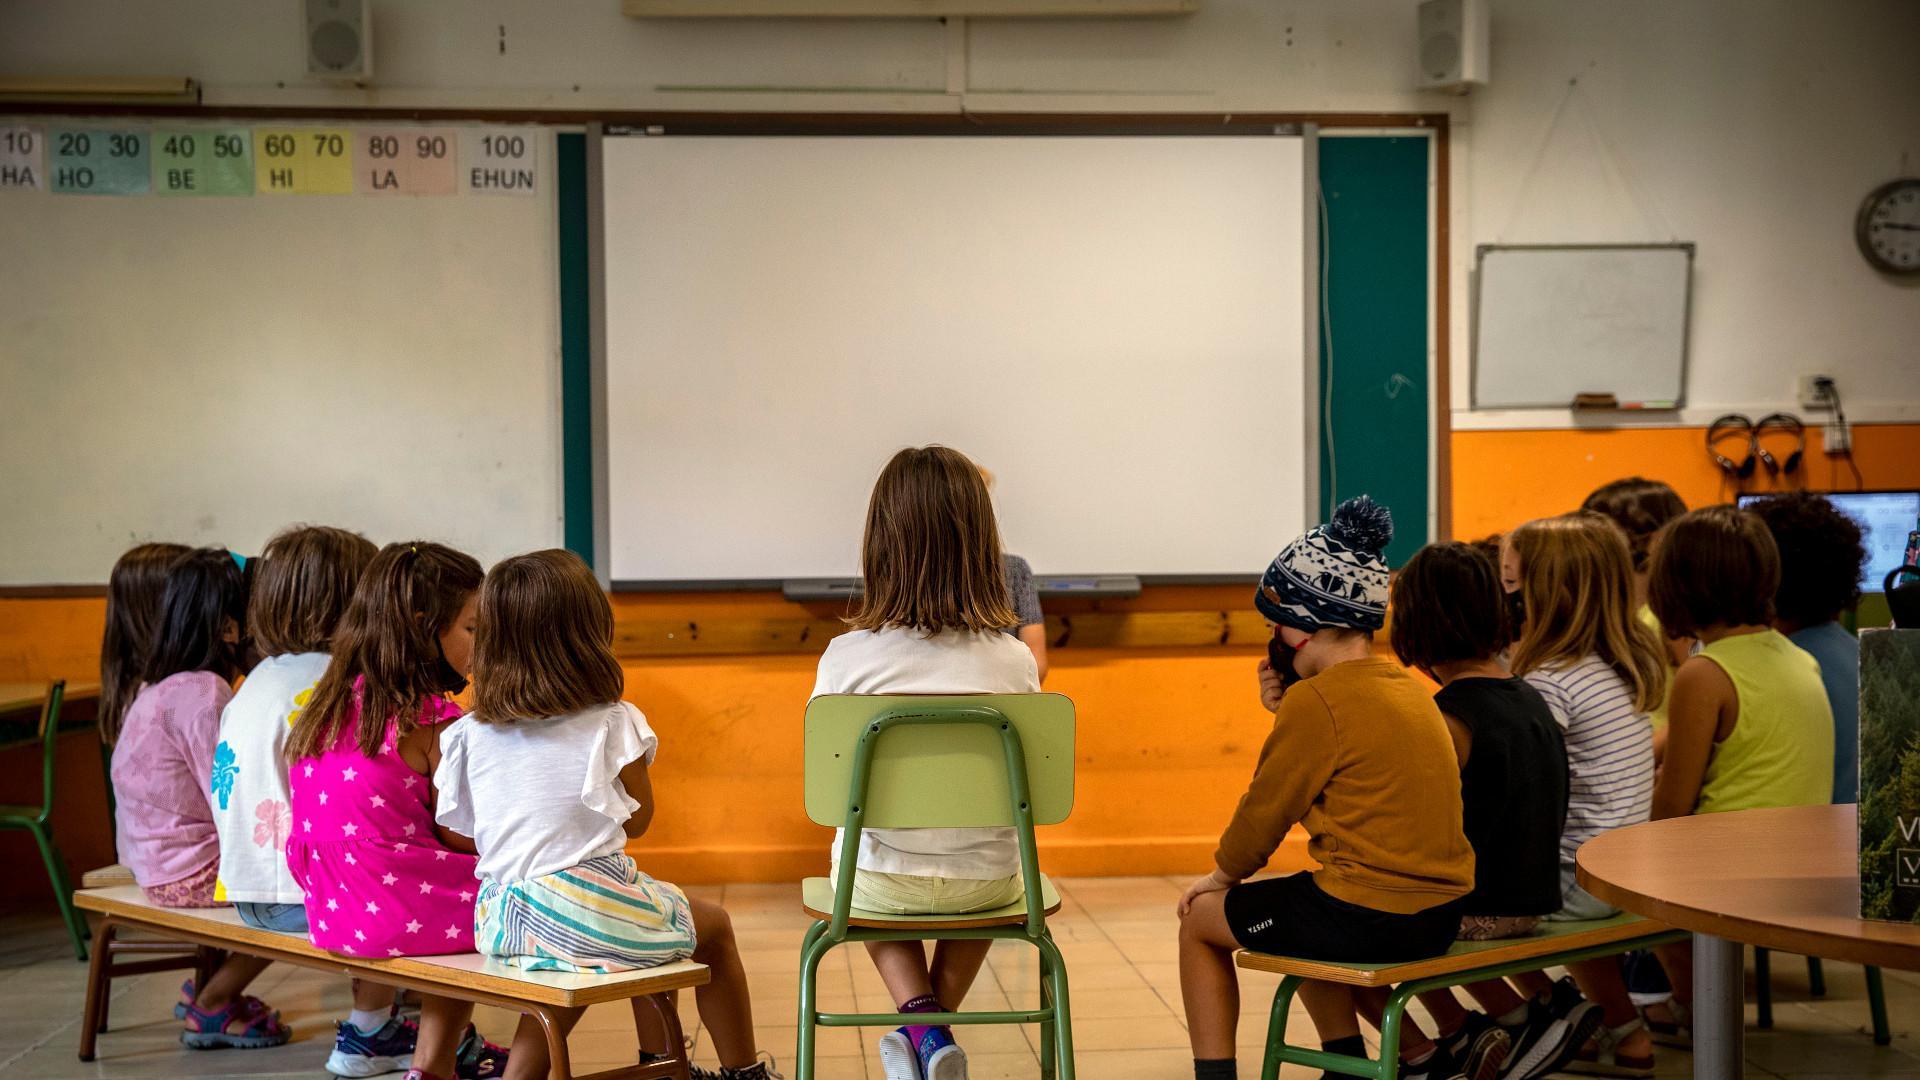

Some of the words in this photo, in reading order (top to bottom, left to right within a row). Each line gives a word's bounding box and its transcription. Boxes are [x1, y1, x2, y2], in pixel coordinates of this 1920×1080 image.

[5, 131, 33, 155] 10
[59, 132, 91, 157] 20
[109, 133, 140, 158] 30
[164, 134, 195, 159] 40
[213, 134, 243, 158] 50
[264, 134, 296, 158] 60
[314, 134, 344, 158] 70
[368, 135, 399, 159] 80
[416, 135, 447, 159] 90
[482, 135, 525, 159] 100
[2, 165, 36, 186] HA
[58, 167, 95, 188] HO
[168, 168, 195, 190] BE
[271, 168, 293, 188] HI
[371, 169, 399, 190] LA
[471, 167, 534, 189] EHUN
[1247, 918, 1274, 933] KIPSTA
